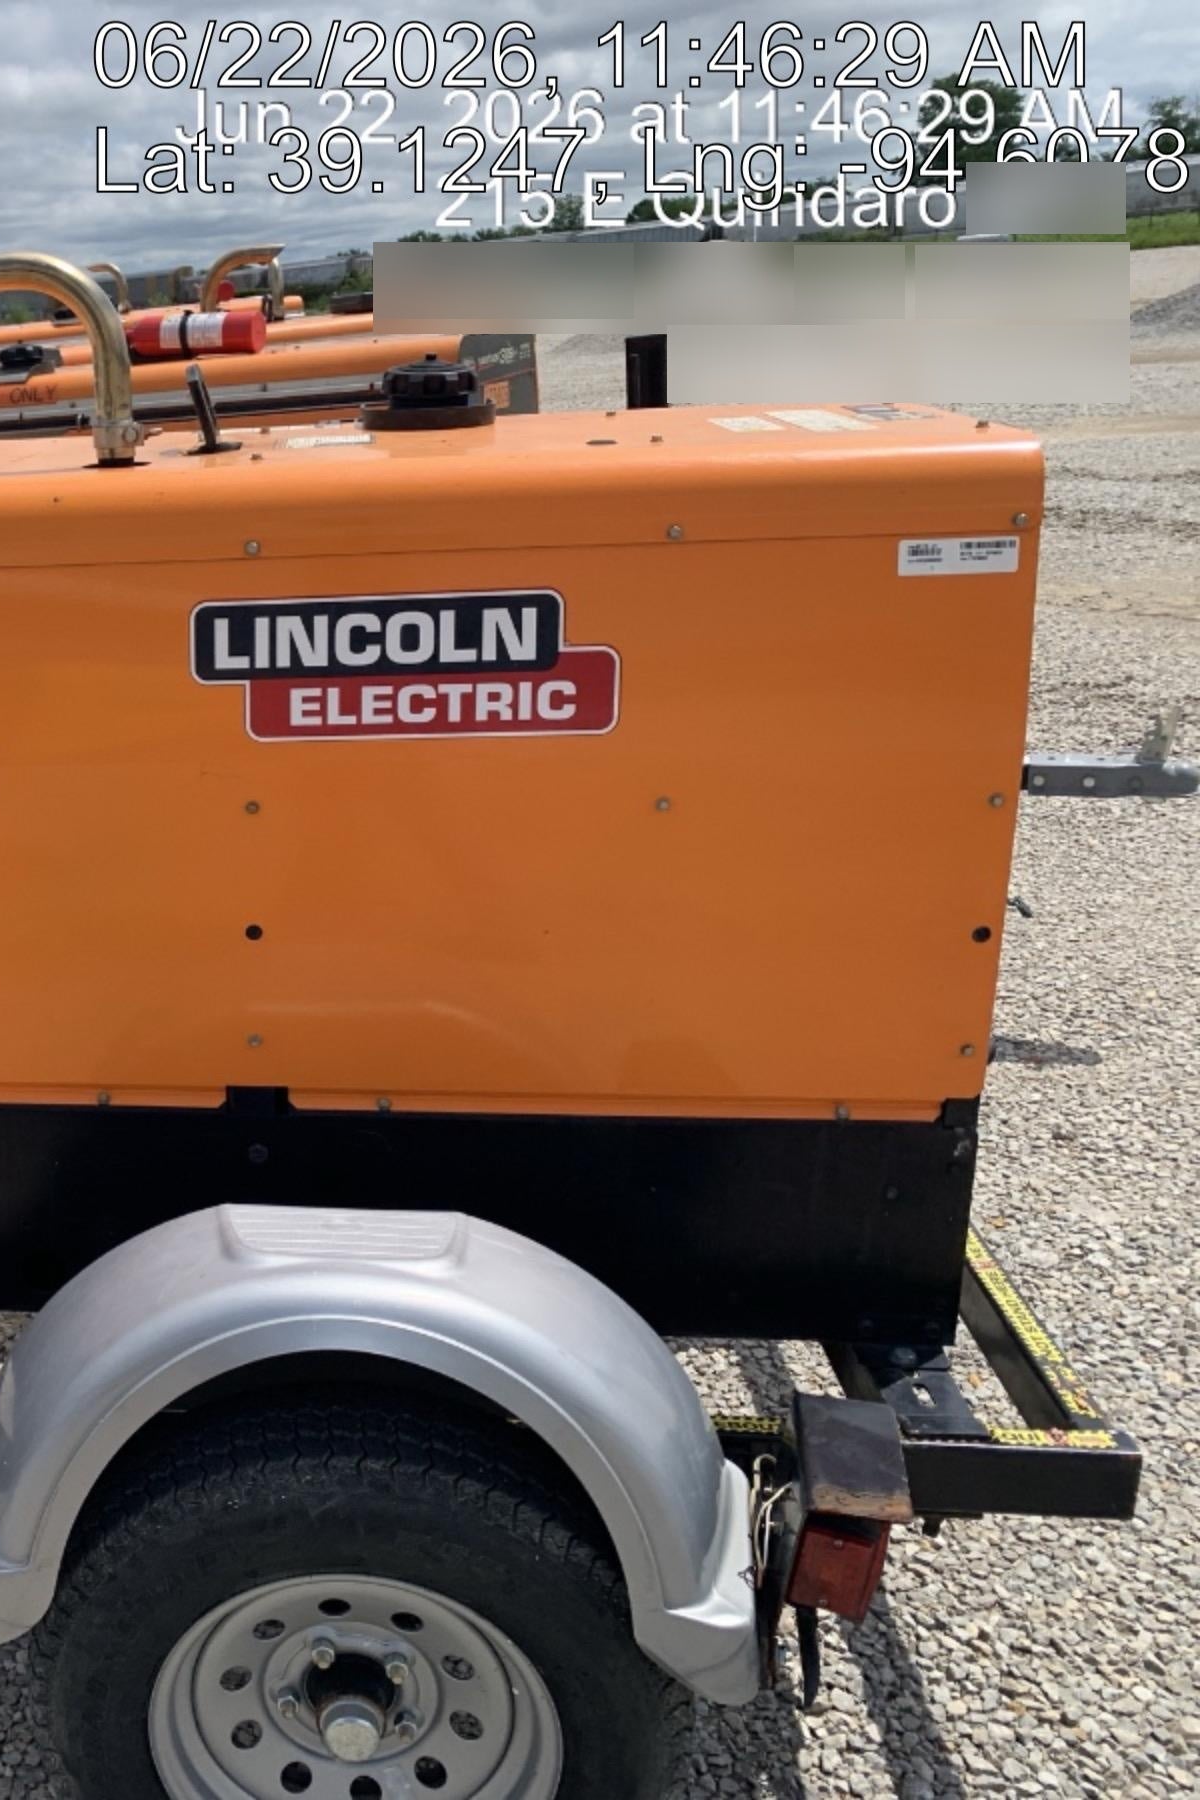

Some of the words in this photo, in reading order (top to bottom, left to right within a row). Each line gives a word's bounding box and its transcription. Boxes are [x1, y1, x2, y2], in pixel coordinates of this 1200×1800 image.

[8, 384, 58, 405] ONLY
[213, 607, 538, 670] LINCOLN
[289, 680, 577, 726] ELECTRIC
